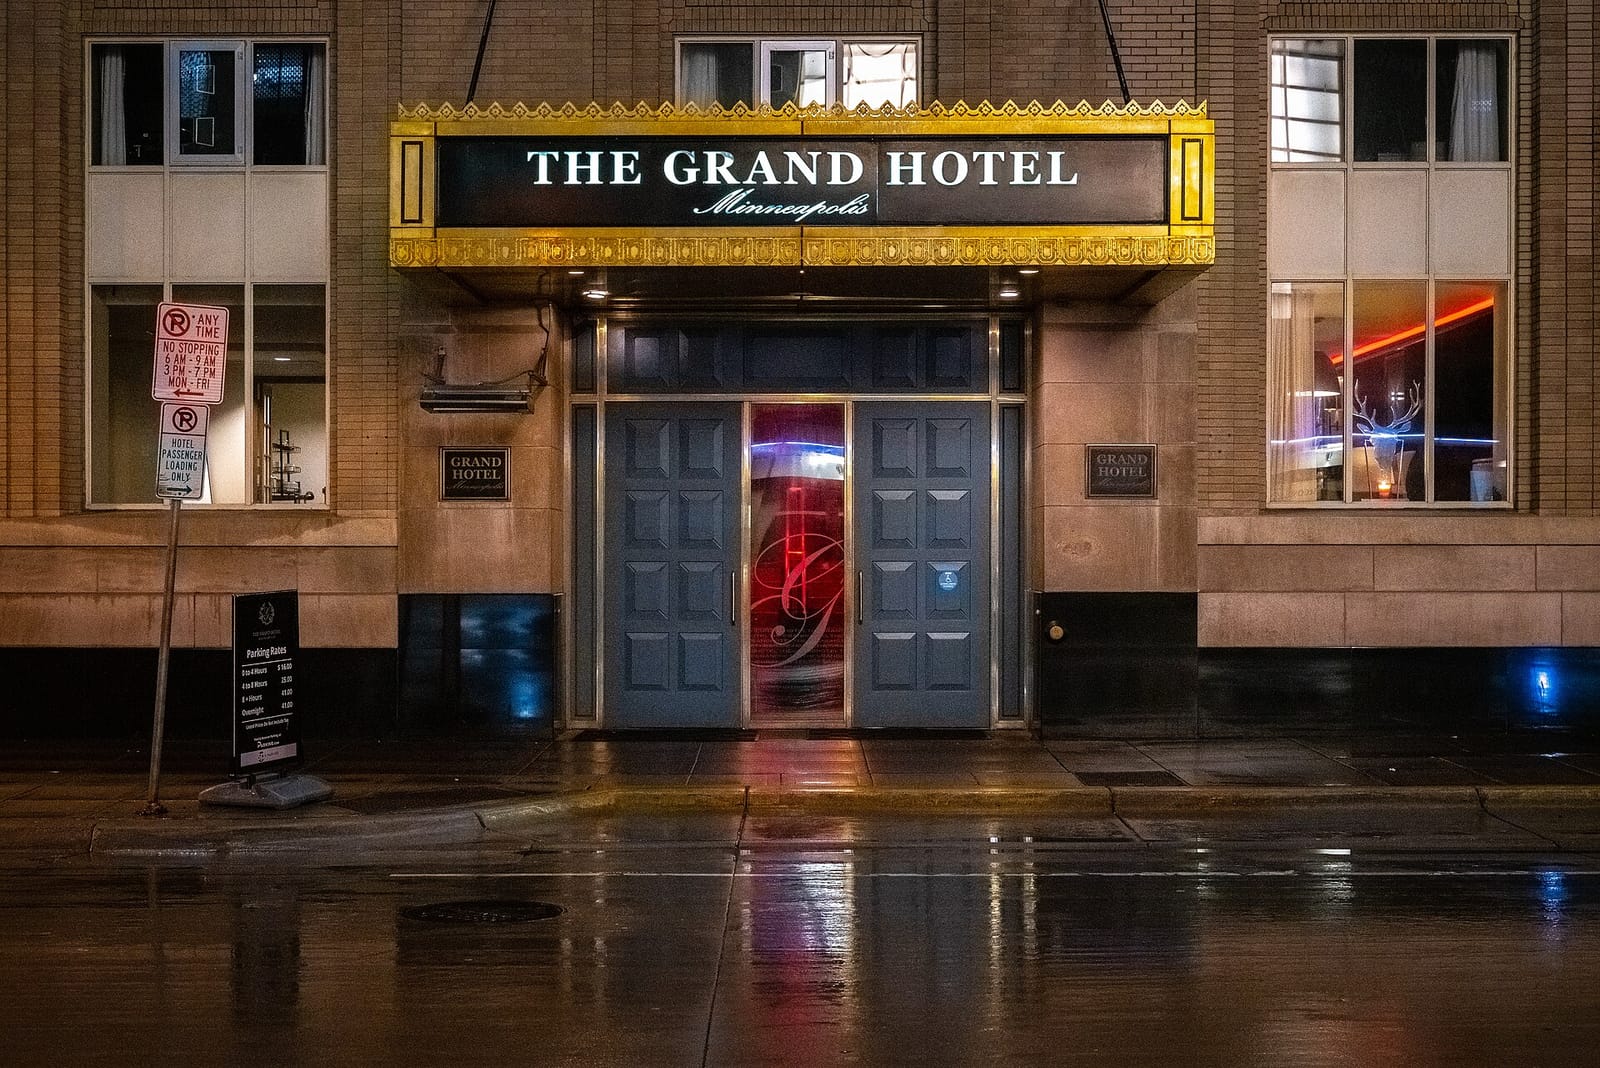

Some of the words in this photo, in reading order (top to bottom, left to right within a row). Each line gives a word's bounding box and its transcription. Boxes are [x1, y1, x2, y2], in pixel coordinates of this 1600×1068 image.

[528, 151, 641, 185] THE
[663, 150, 864, 186] GRAND
[886, 151, 1078, 186] HOTEL
[693, 188, 869, 221] Minneapolis
[198, 314, 219, 326] ANY
[196, 326, 220, 338] TIME
[163, 341, 175, 352] NO
[178, 343, 220, 356] STOPPING
[165, 353, 170, 364] 6
[174, 354, 186, 365] AM
[196, 355, 201, 365] 9
[204, 356, 216, 367] AM
[164, 365, 169, 375] 3
[172, 366, 185, 376] PM
[195, 367, 200, 378] 7
[204, 368, 216, 378] PM
[168, 377, 187, 388] MON
[196, 379, 210, 390] FRI
[172, 438, 194, 449] HOTEL
[162, 448, 203, 460] PASSENGER
[1096, 454, 1148, 465] GRAND
[165, 460, 198, 471] LOADING
[450, 456, 502, 467] GRAND
[171, 472, 190, 482] ONLY
[452, 469, 501, 480] HOTEL
[1097, 466, 1147, 477] HOTEL
[246, 647, 270, 659] Parking
[270, 646, 287, 656] Rates
[254, 667, 268, 675] Hours
[254, 680, 268, 688] Hours
[248, 694, 263, 702] Hours
[241, 706, 264, 717] Overnight
